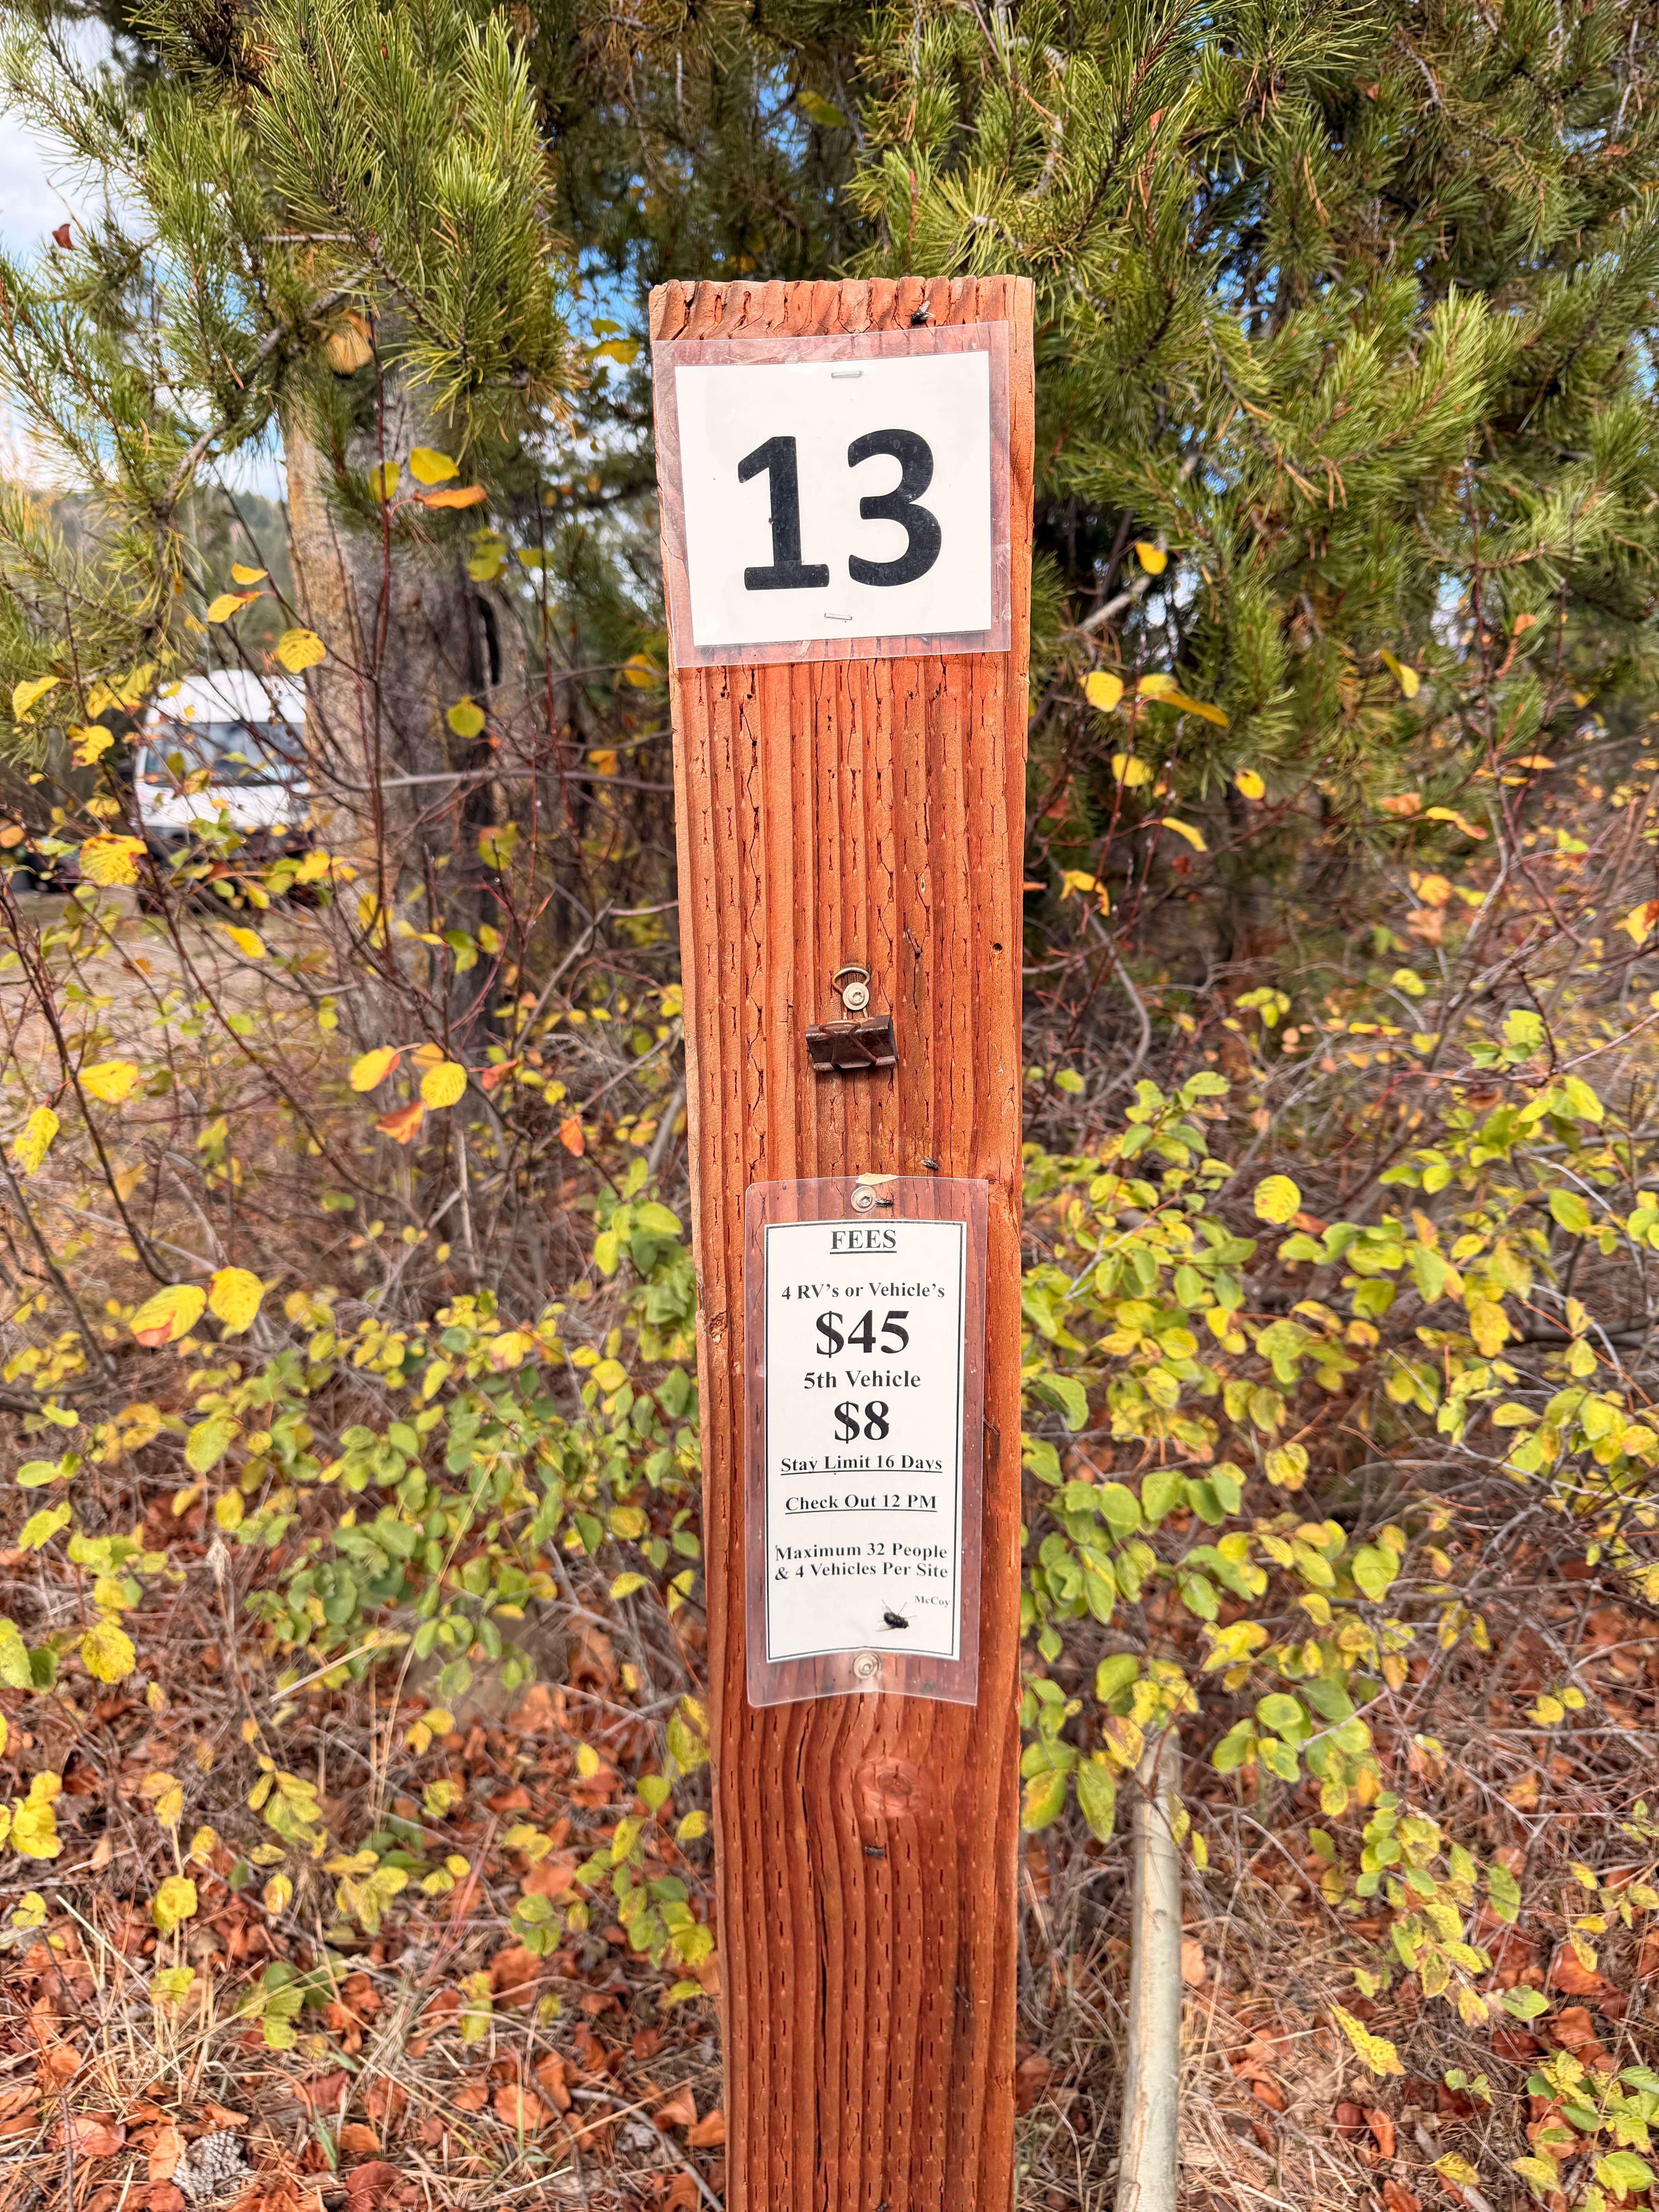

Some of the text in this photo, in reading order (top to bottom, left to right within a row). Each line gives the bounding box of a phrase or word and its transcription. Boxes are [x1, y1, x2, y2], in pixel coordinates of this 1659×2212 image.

[737, 429, 942, 591] 13
[831, 1230, 896, 1249] FEES
[781, 1286, 791, 1300] 4
[845, 1286, 864, 1297] or
[816, 1310, 909, 1358] $45
[804, 1370, 921, 1389] 5th Vehicle
[834, 1400, 890, 1444] $8
[781, 1455, 942, 1473] Stay Limit 16 Days
[786, 1494, 936, 1511] Check Out 12 PM
[775, 1542, 947, 1561] Maximum 32 People
[775, 1562, 948, 1580] & 4 Vehicles Per Site
[915, 1595, 950, 1607] McCoy
